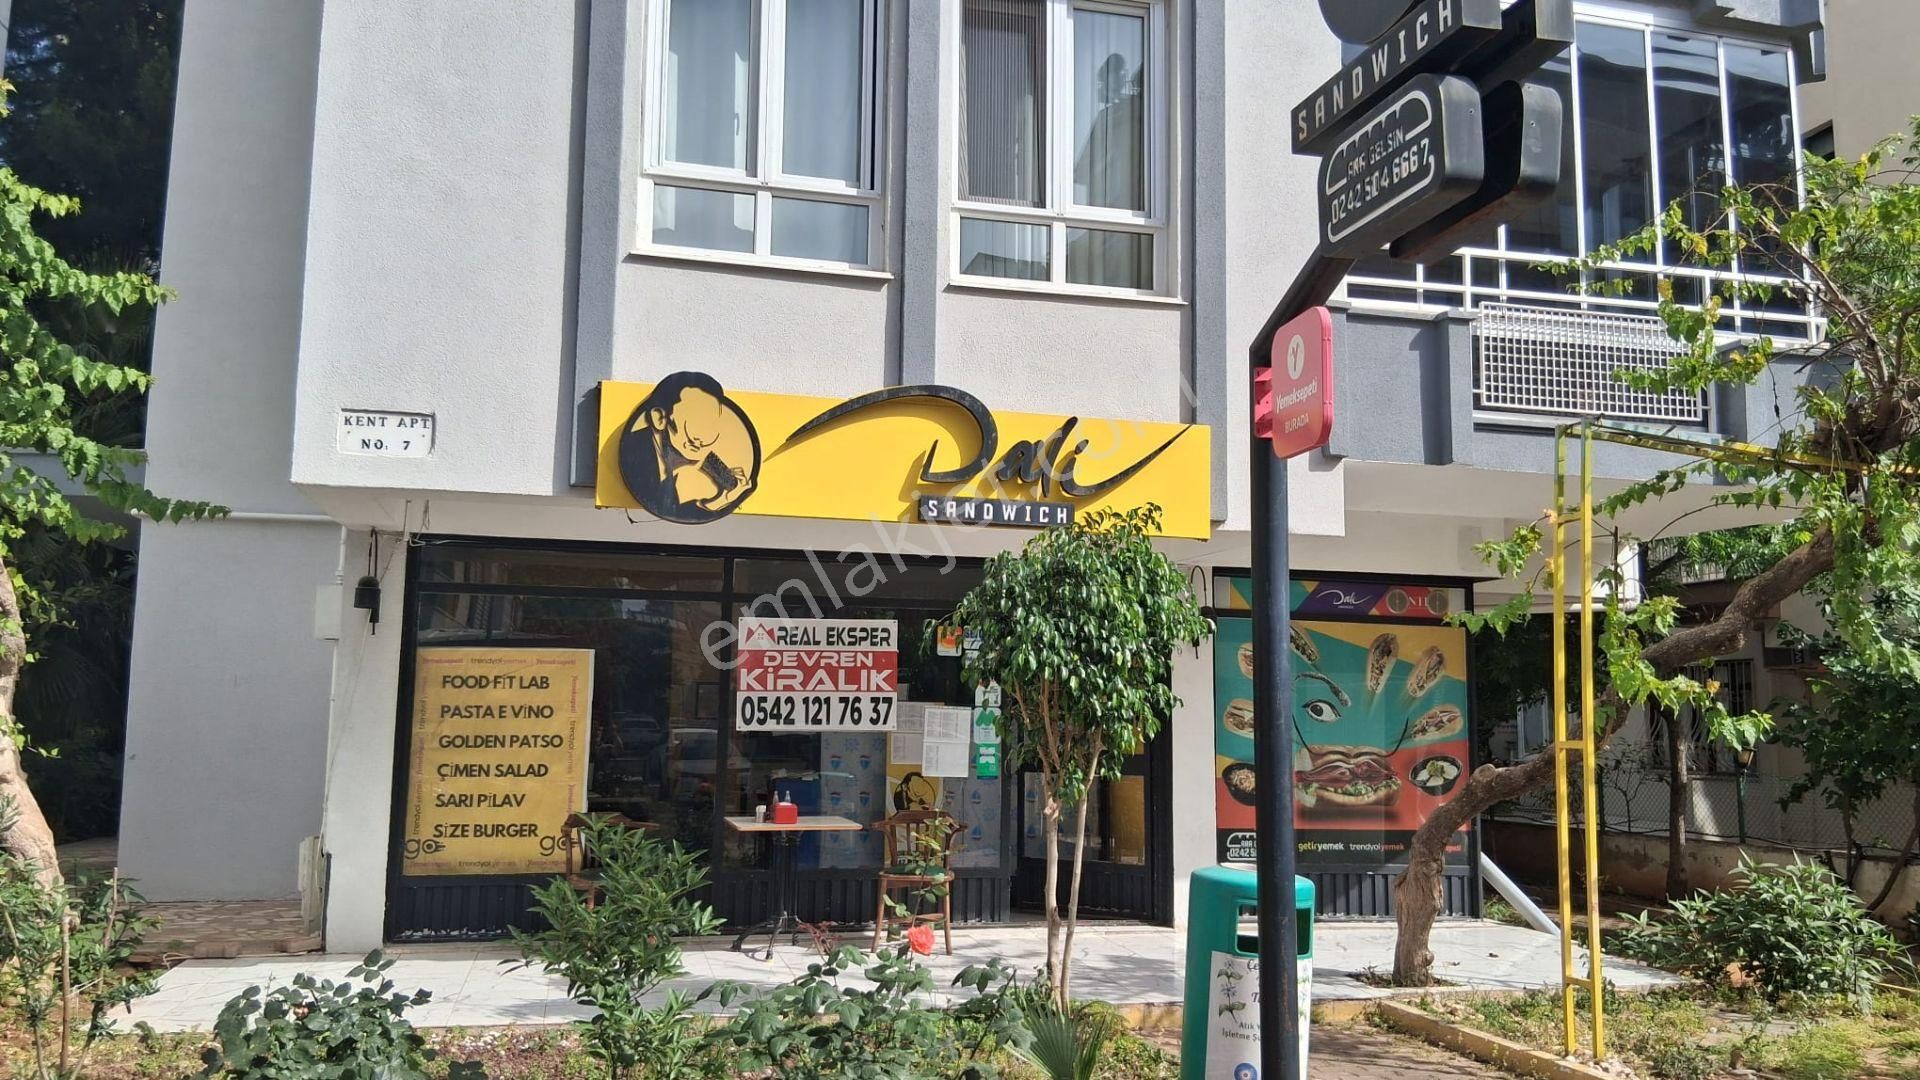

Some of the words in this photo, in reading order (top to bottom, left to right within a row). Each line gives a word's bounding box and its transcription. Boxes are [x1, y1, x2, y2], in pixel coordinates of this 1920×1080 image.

[1298, 0, 1451, 141] SANDWICH
[1332, 183, 1362, 224] 0242
[1364, 170, 1389, 201] 504
[1276, 377, 1318, 413] Yemeksepeti
[344, 416, 388, 427] KENT
[1284, 413, 1309, 434] BURADA
[403, 440, 411, 450] 7
[928, 499, 1068, 524] SANDWICH
[777, 626, 820, 646] REAL
[826, 626, 891, 647] EKSPER
[763, 651, 873, 667] DEVREN
[442, 675, 489, 689] FOOD
[519, 675, 550, 689] LAB
[440, 705, 495, 719] PASTA
[499, 705, 506, 718] E
[741, 696, 795, 726] 0542
[802, 696, 831, 725] 121
[838, 696, 862, 726] 76
[869, 696, 893, 726] 37
[439, 735, 505, 748] GOLDEN
[509, 735, 563, 748] PATSO
[494, 764, 549, 777] SALAD
[435, 794, 473, 807] SARI
[473, 824, 538, 838] BURGER
[1230, 849, 1249, 857] 0242
